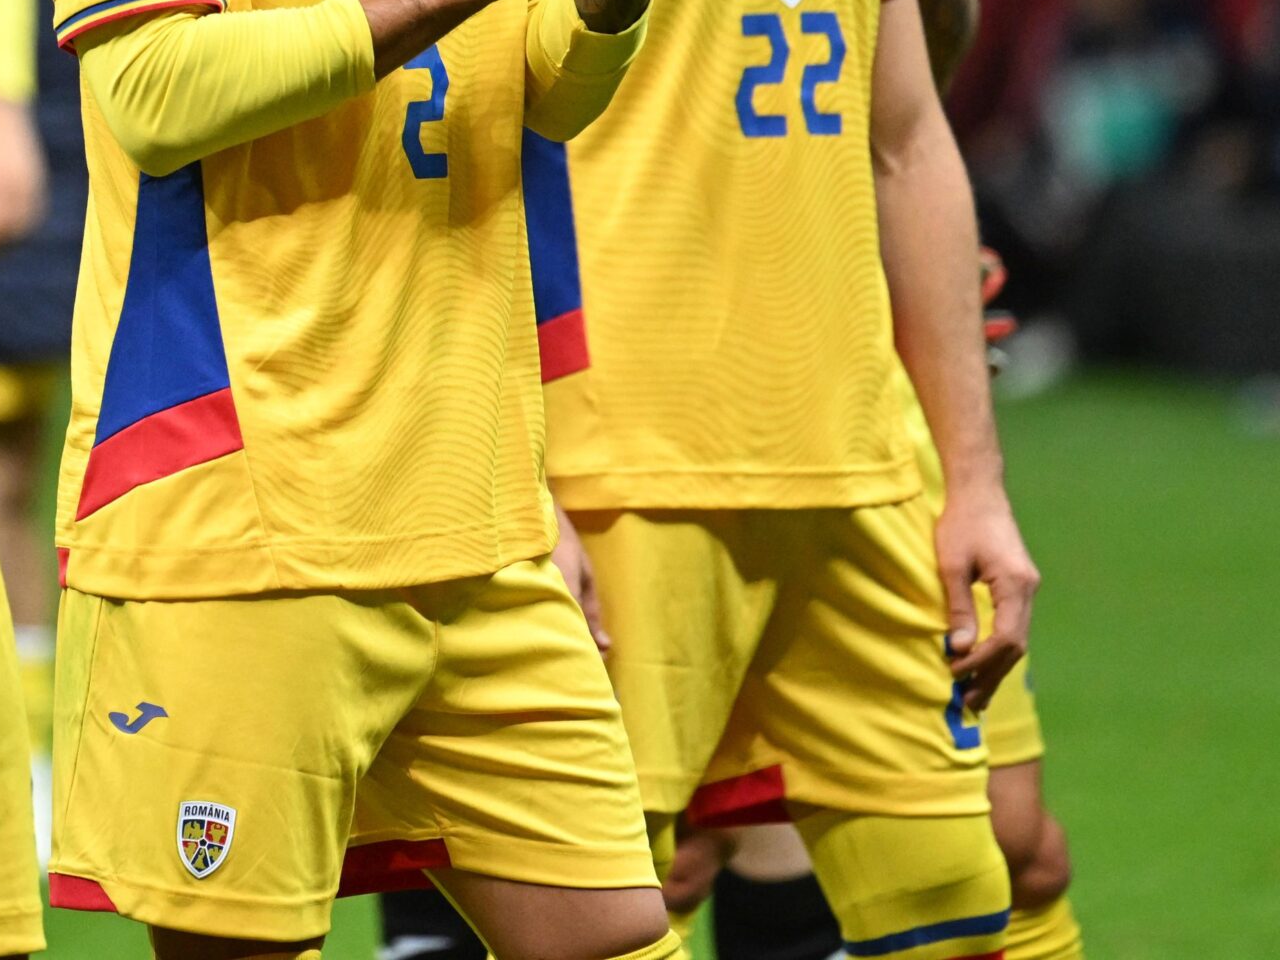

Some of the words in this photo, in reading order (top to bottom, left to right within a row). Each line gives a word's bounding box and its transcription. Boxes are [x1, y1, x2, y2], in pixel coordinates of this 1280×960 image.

[402, 42, 450, 179] 2
[735, 11, 847, 138] 22
[184, 804, 230, 822] ROMÂNIA
